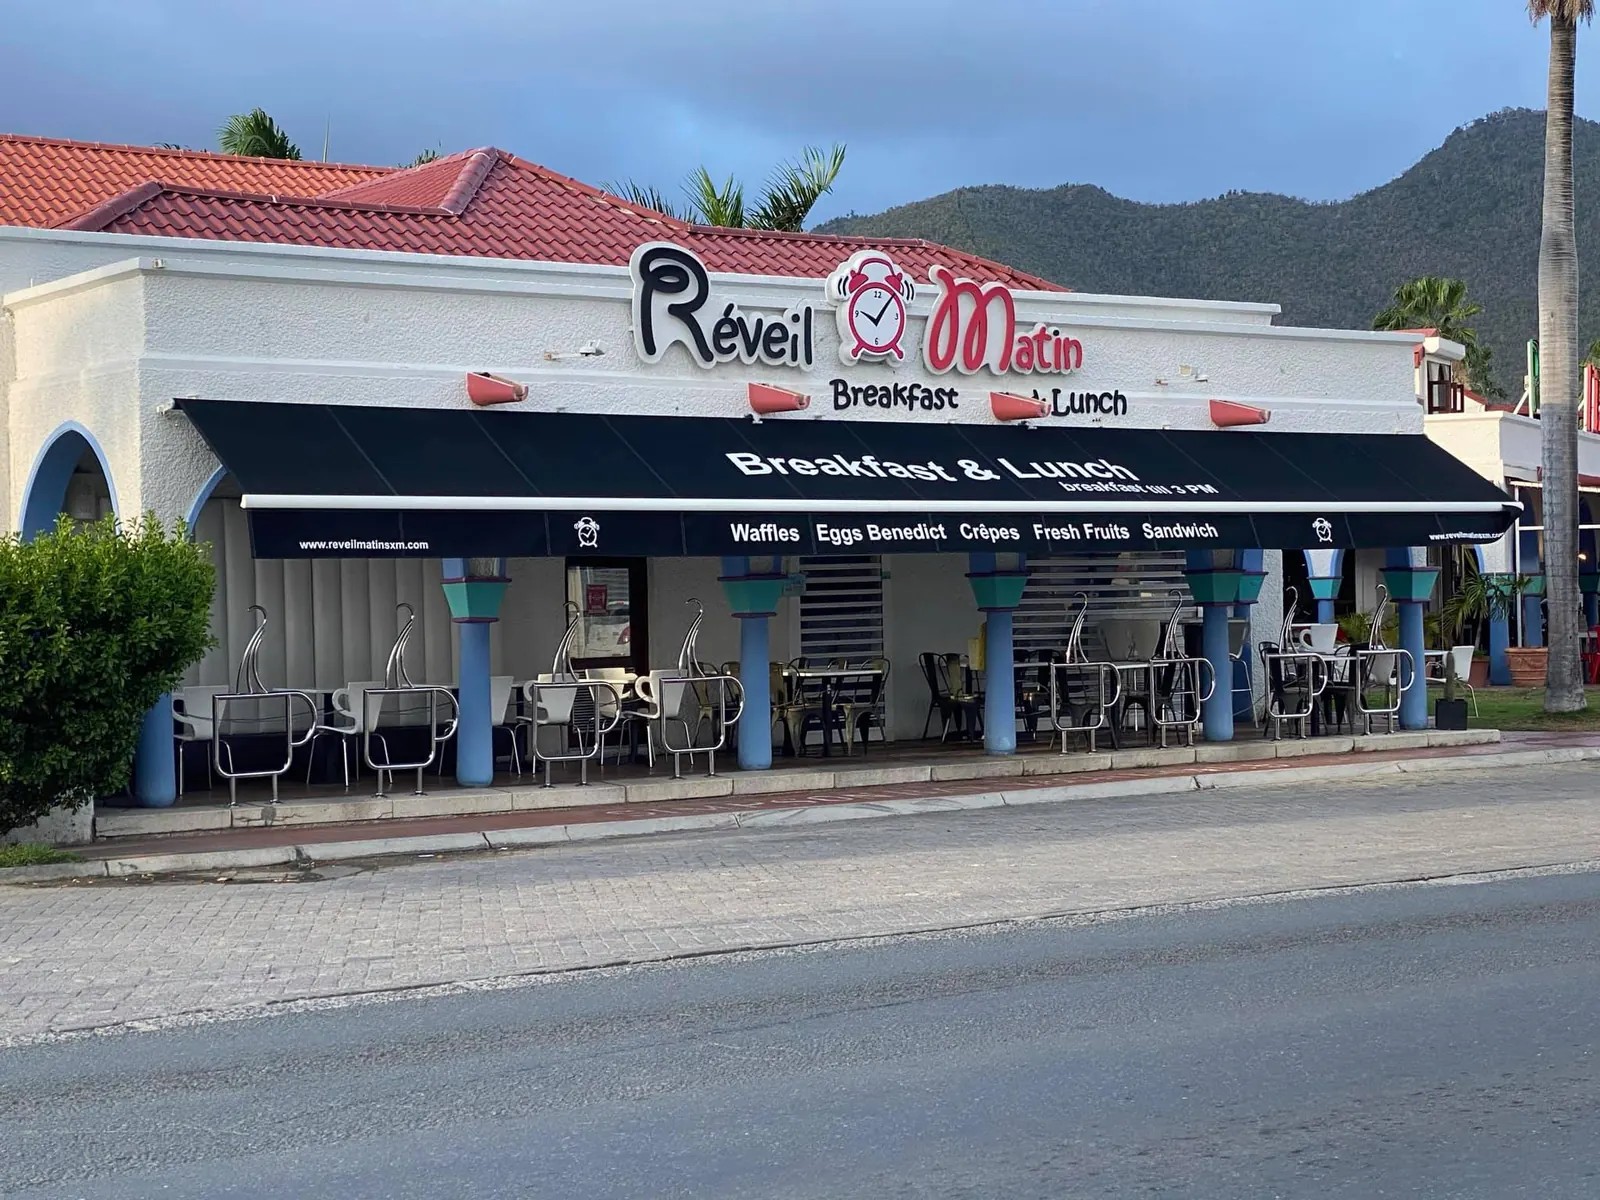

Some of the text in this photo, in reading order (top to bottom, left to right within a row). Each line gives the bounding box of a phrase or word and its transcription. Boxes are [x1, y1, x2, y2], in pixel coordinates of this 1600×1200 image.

[639, 247, 1083, 371] Réveil Matin
[829, 378, 959, 411] Breakfast
[1051, 388, 1128, 417] Lunch
[725, 452, 1140, 482] Breakfast & Lunch
[1058, 481, 1148, 493] breakfast
[1170, 485, 1187, 494] 3
[1184, 483, 1220, 494] PM
[730, 523, 1219, 544] Waffles Eggs Benedict Crêpes Fresh Fruits Sandwich
